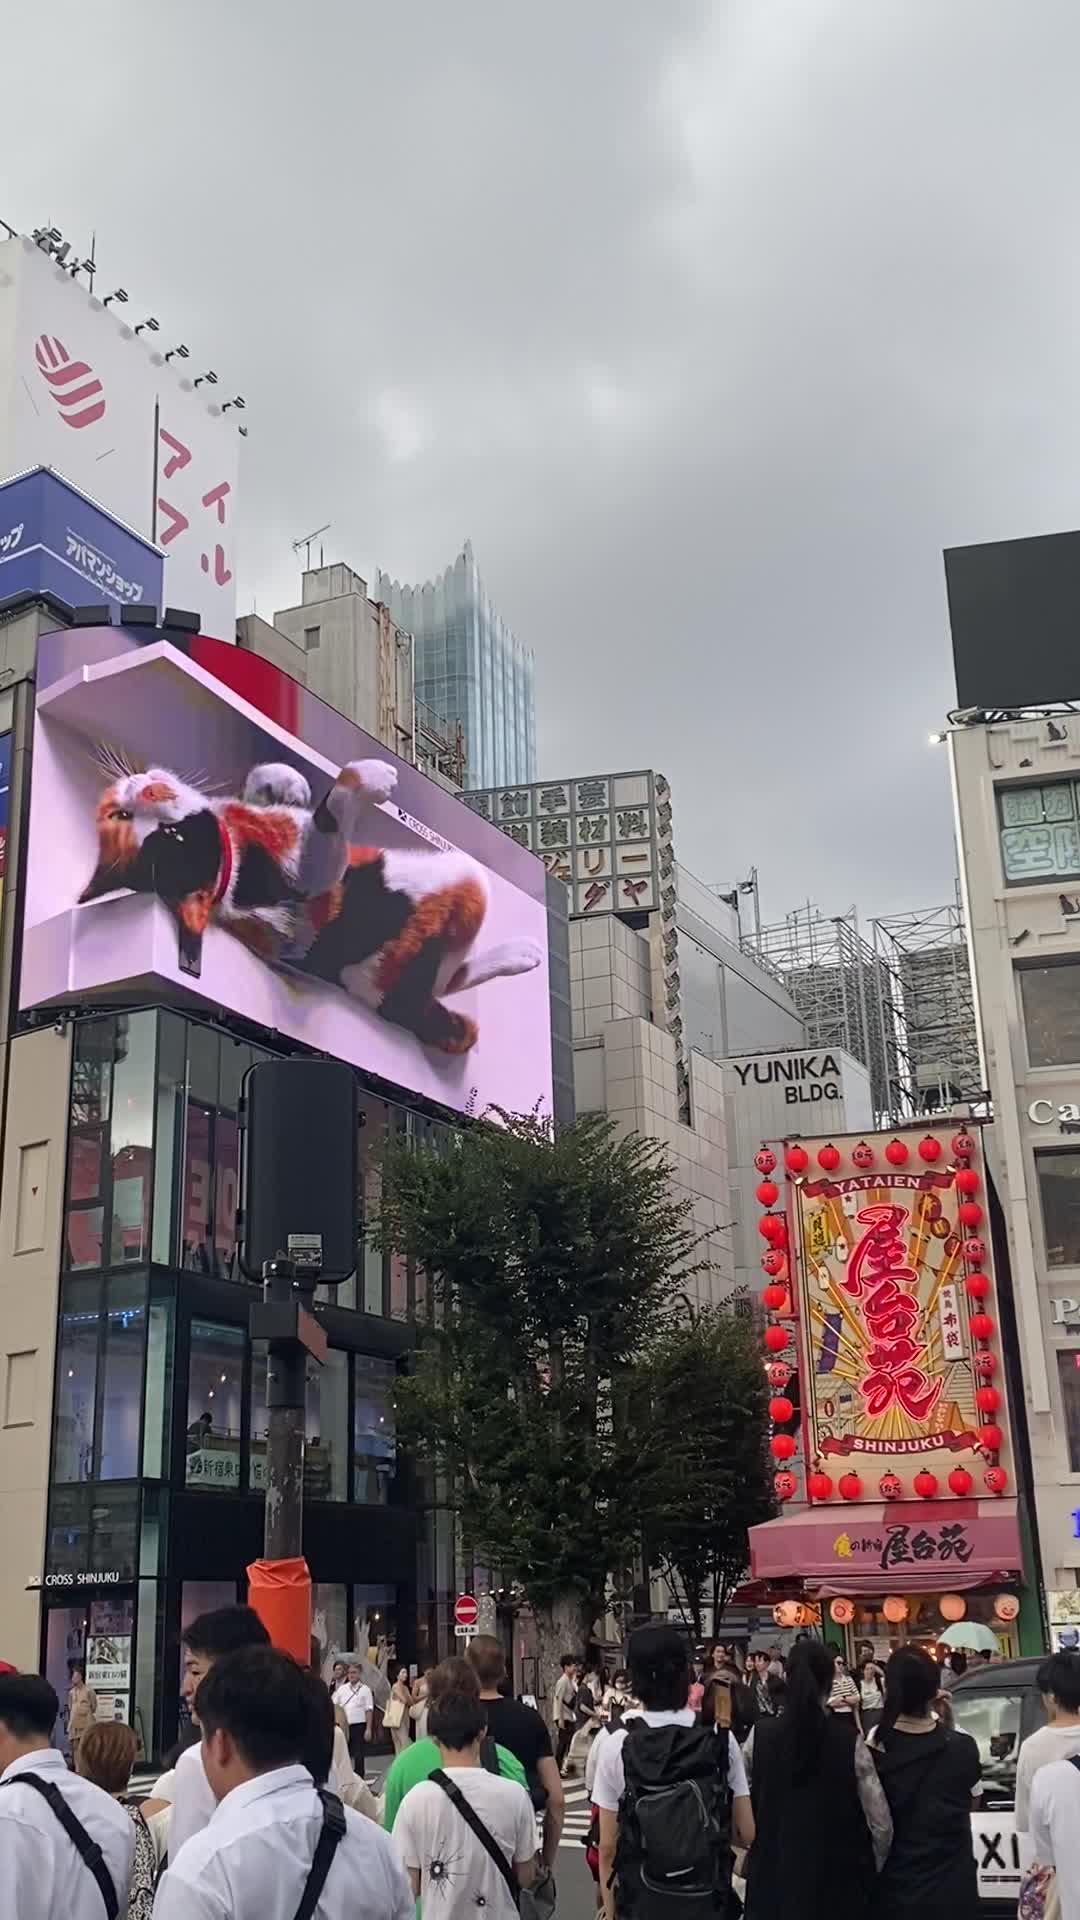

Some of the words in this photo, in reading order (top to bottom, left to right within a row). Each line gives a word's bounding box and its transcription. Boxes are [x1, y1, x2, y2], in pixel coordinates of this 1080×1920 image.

[65, 535, 144, 602] アパマンショップ
[733, 1055, 841, 1086] YUNIKA
[785, 1082, 844, 1104] BLDG.
[834, 1174, 920, 1193] YATAIEN
[853, 1435, 945, 1452] SHINJUKU
[878, 1524, 976, 1569] 屋台苑
[45, 1573, 74, 1586] CROSS
[76, 1571, 119, 1585] SHINJUKU
